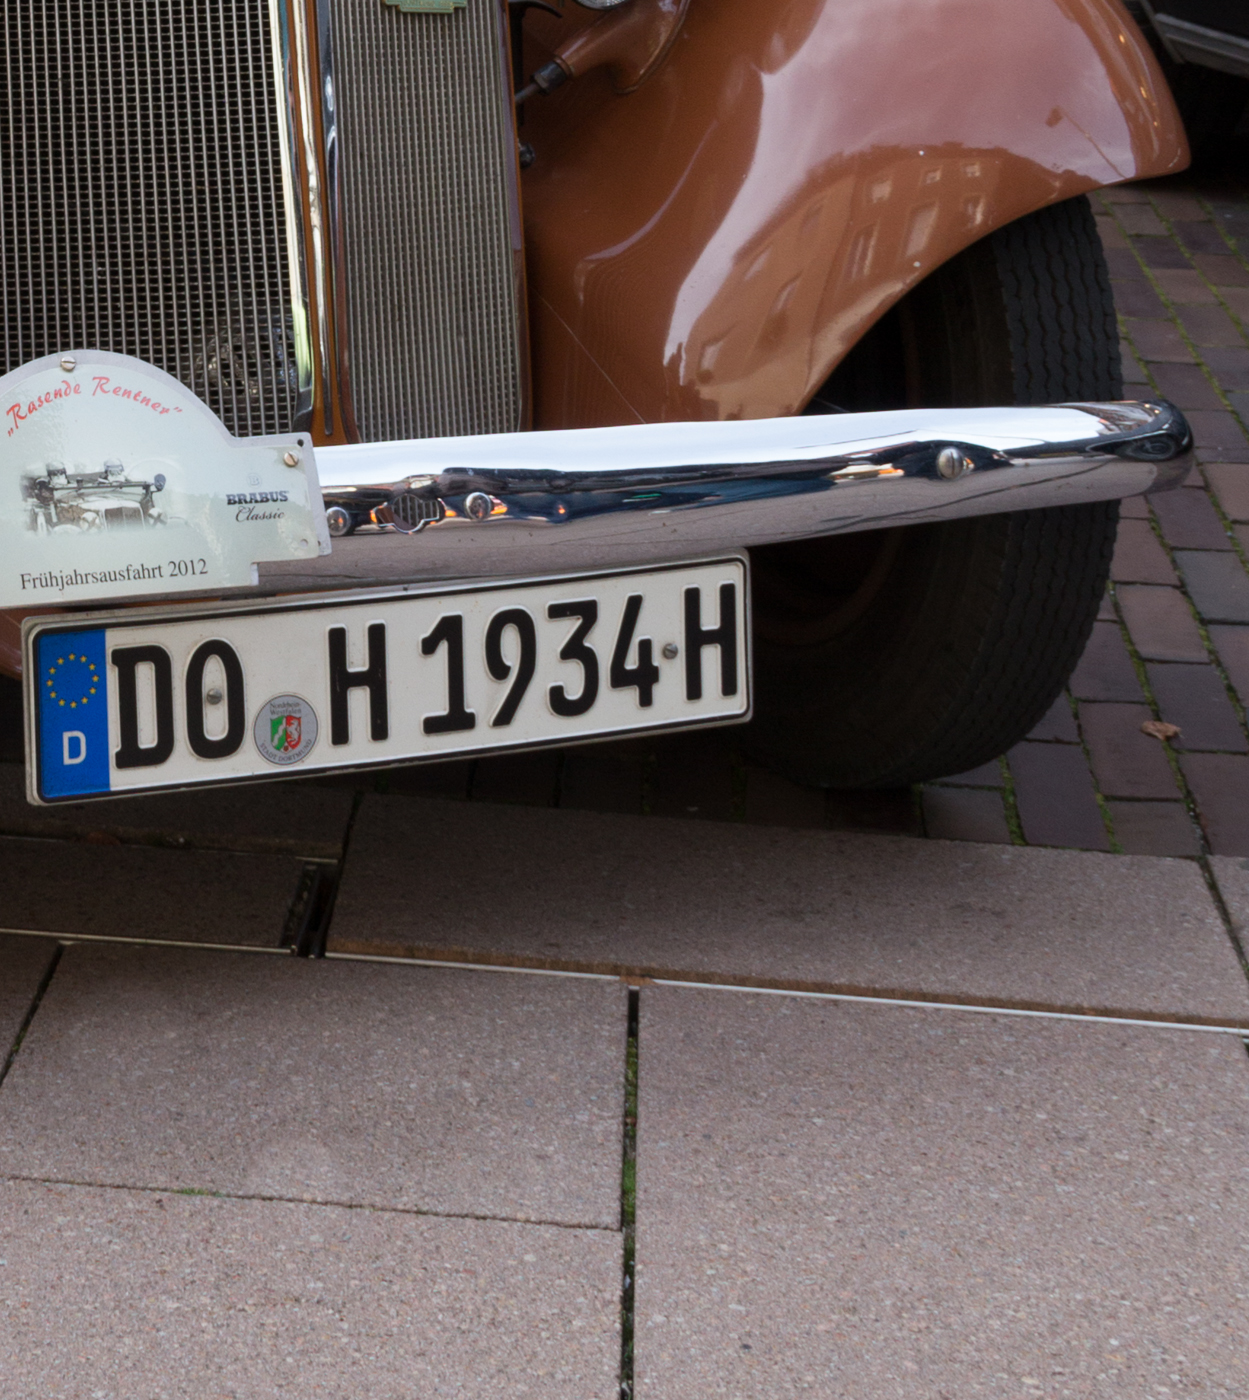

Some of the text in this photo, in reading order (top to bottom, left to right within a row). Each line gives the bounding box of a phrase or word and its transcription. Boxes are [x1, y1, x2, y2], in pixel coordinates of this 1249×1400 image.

[226, 490, 289, 506] BRABUS
[235, 505, 285, 523] Classic
[20, 557, 209, 591] Frühjahrsausfahrt 2012
[111, 637, 246, 770] DO
[63, 729, 87, 766] D
